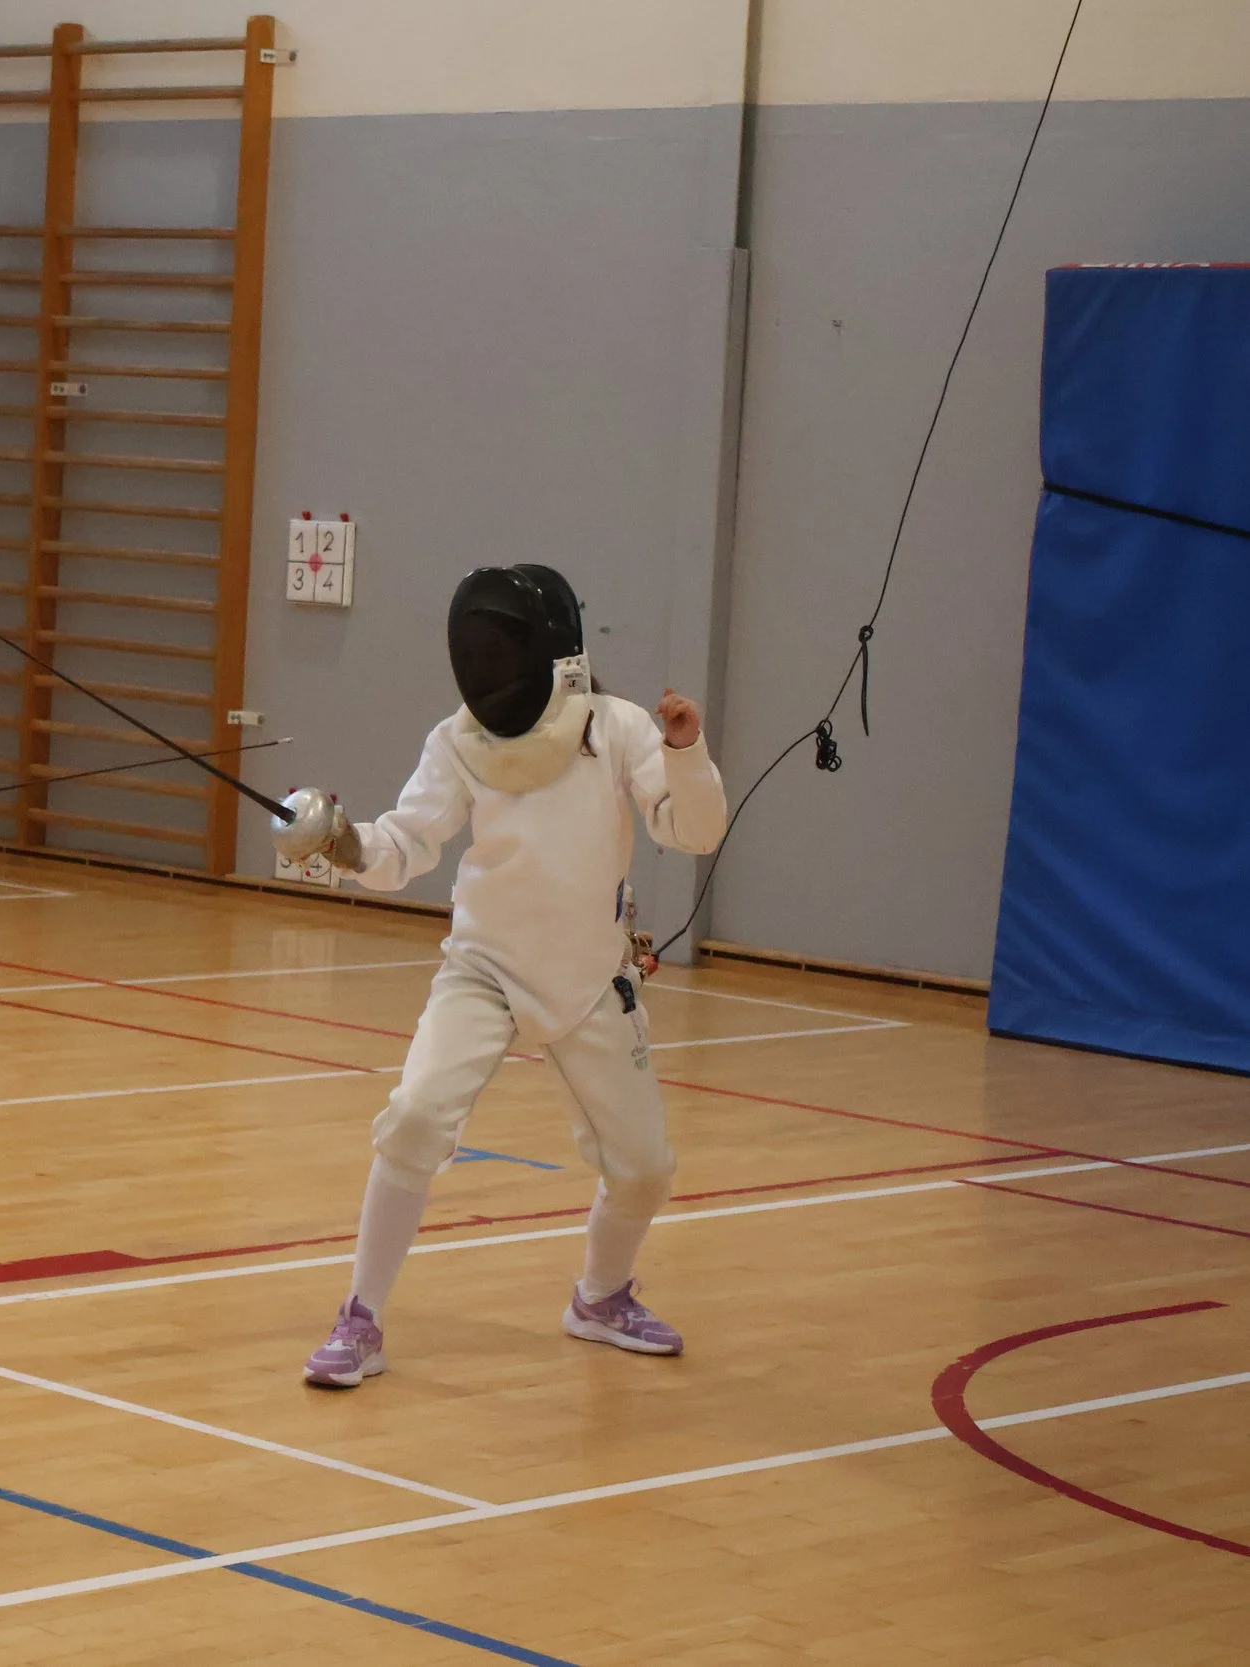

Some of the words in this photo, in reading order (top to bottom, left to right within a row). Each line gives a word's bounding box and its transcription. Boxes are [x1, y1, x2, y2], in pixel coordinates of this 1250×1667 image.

[295, 532, 304, 553] 1
[323, 531, 334, 552] 2
[293, 568, 304, 590] 3
[322, 570, 334, 591] 4
